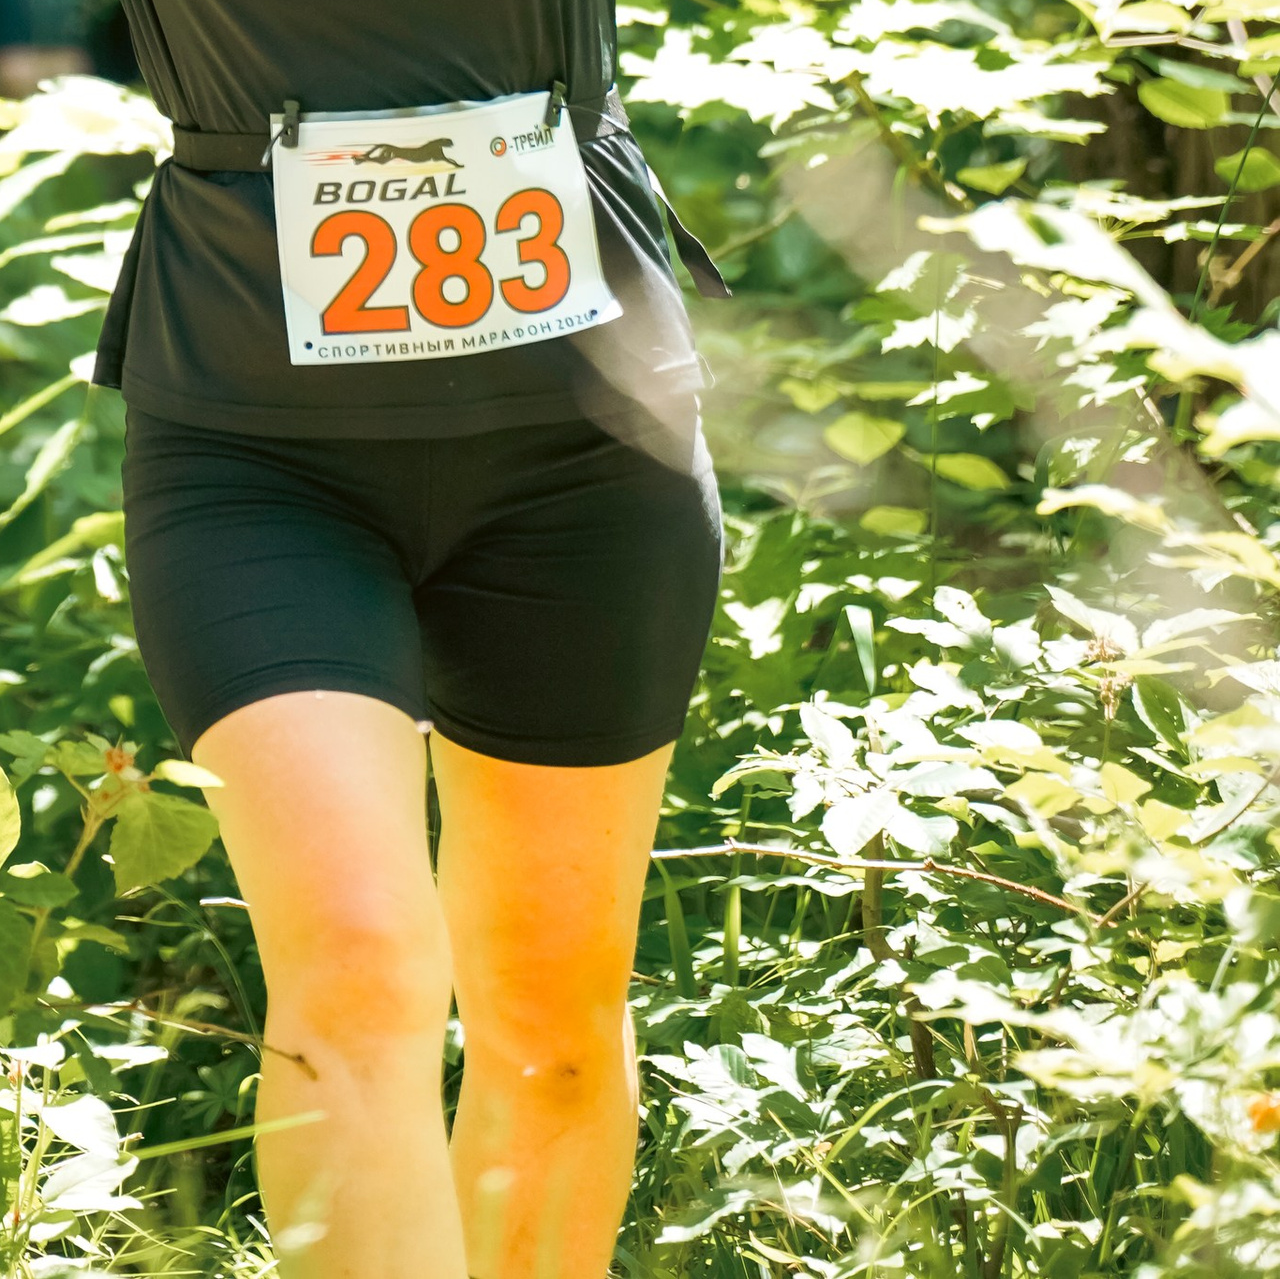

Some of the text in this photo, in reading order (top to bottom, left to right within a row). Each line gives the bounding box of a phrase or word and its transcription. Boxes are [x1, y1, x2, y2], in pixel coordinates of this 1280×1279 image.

[312, 173, 468, 206] BOGAL
[309, 187, 572, 336] 283
[317, 338, 456, 360] СПОРТИВНЫЙ
[461, 320, 552, 350] МАРАФОН
